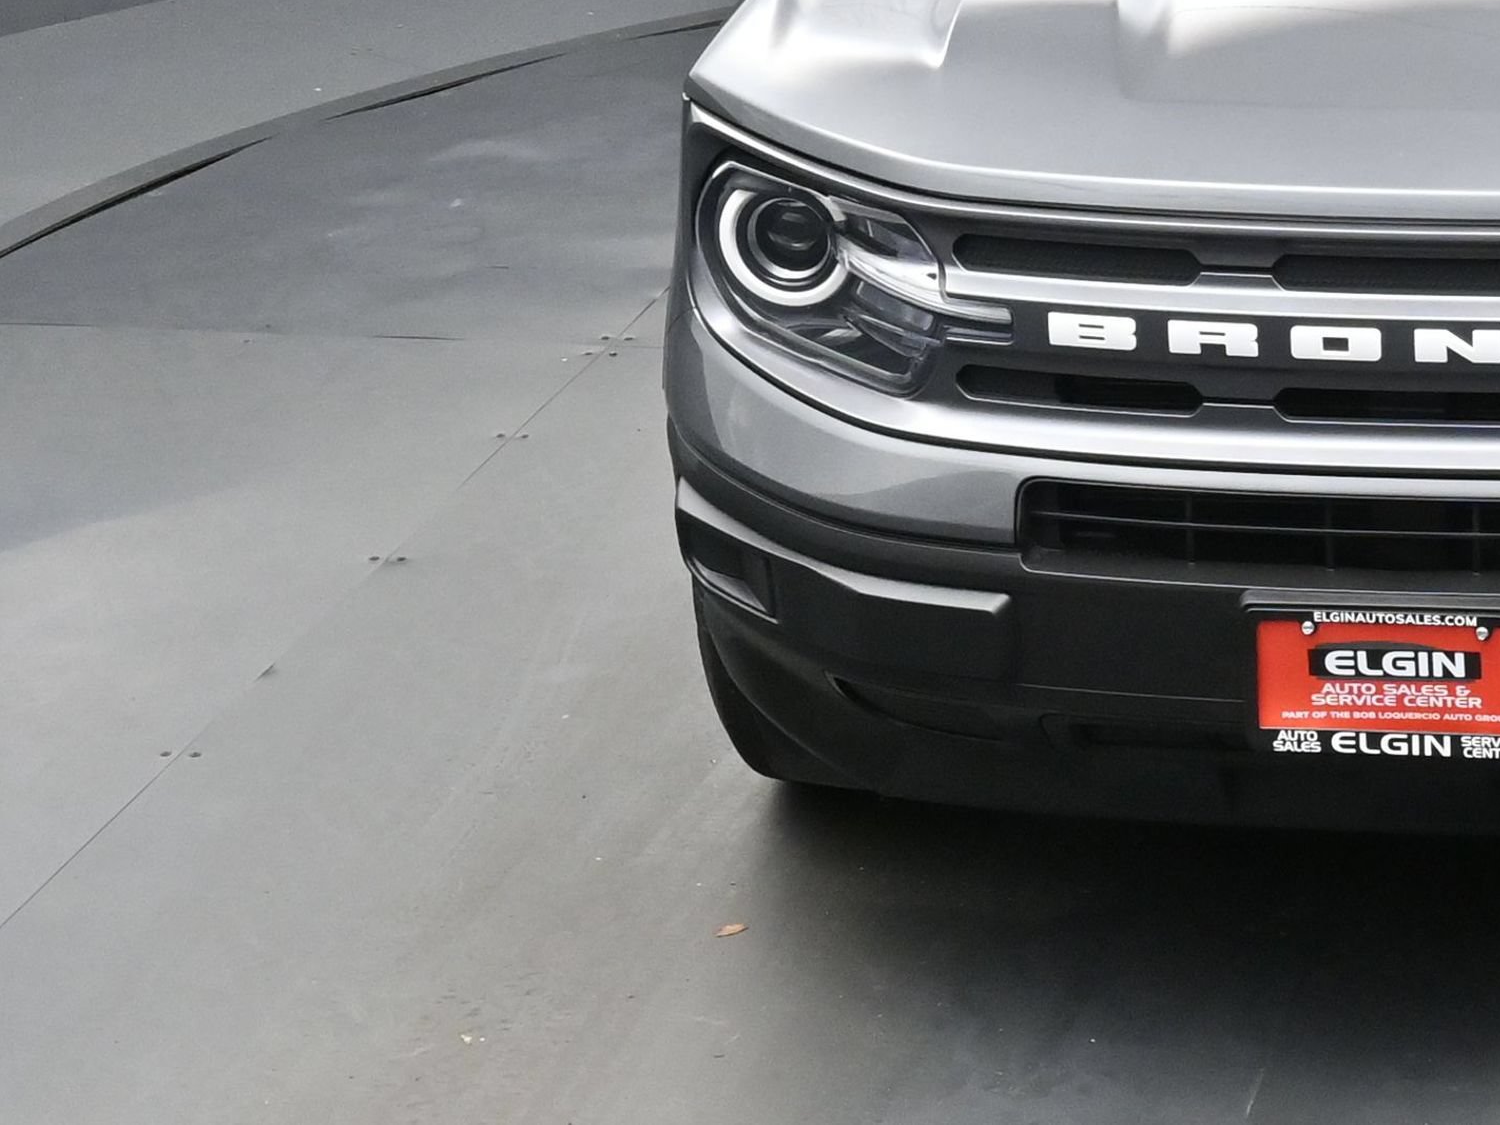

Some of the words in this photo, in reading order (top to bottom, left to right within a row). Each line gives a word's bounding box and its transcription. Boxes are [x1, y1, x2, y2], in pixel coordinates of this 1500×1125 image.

[1313, 611, 1478, 627] ELGINAUTOSALES.COM
[1324, 650, 1466, 678] ELGIN
[1321, 682, 1377, 695] AUTO
[1383, 683, 1449, 697] SALES
[1455, 685, 1471, 696] &
[1311, 694, 1397, 707] SERVICE
[1403, 696, 1482, 709] CENTER
[1281, 711, 1310, 719] PART
[1312, 711, 1328, 719] OF
[1330, 711, 1351, 719] THE
[1353, 711, 1377, 719] BOB
[1378, 712, 1441, 721] LOQUERCIO
[1443, 713, 1473, 722] AUTO
[1277, 730, 1319, 741] AUTO
[1272, 740, 1322, 753] SALES
[1331, 731, 1452, 757] ELGIN
